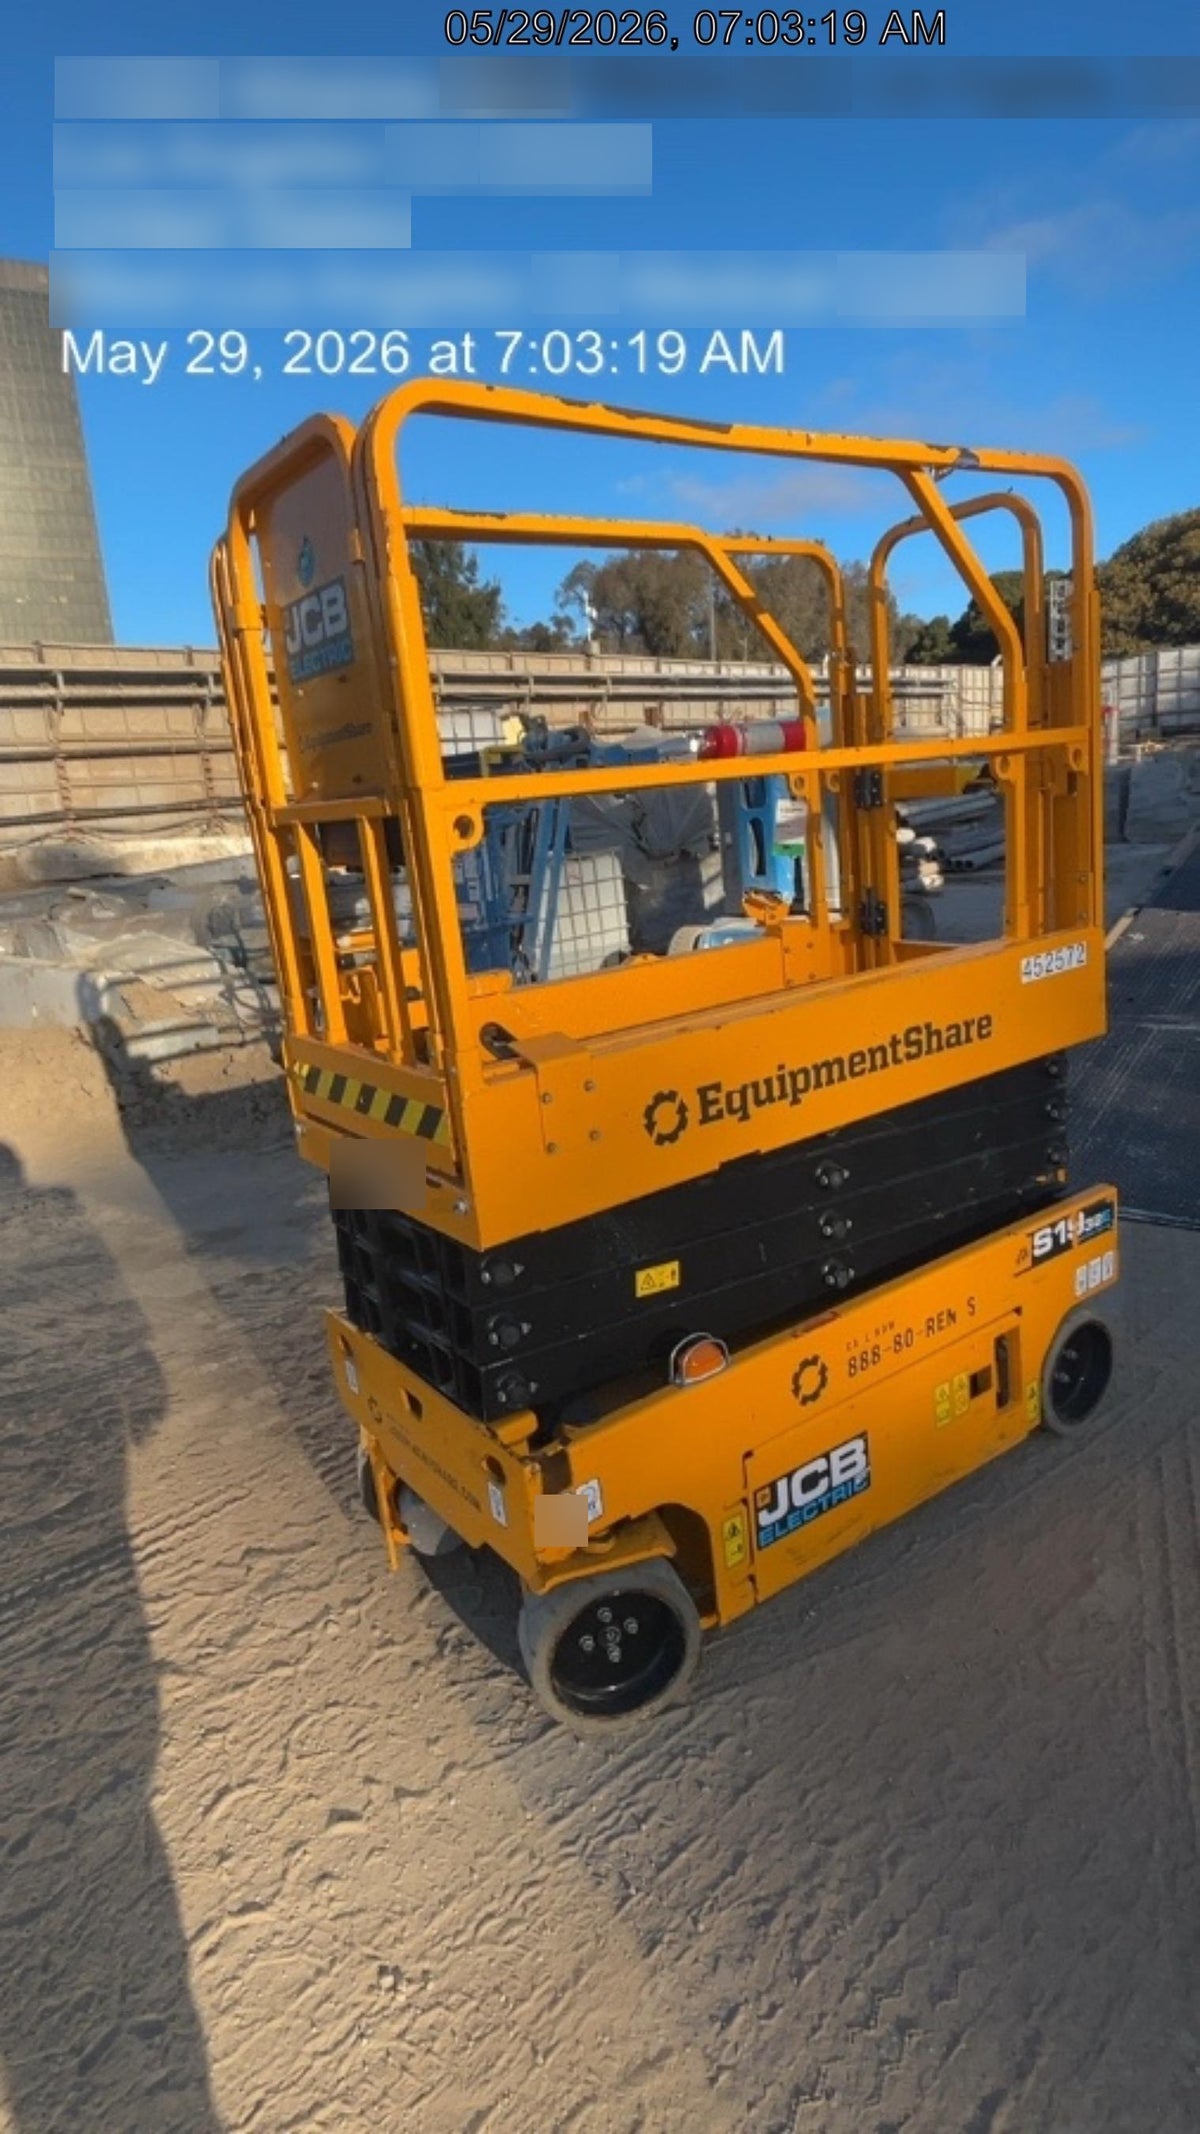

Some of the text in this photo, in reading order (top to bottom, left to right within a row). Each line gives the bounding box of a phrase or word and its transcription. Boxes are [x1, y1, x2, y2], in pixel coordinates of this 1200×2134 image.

[286, 582, 348, 655] JCB
[1024, 943, 1085, 978] 452572
[697, 1013, 993, 1124] EquipmentShare
[758, 1438, 867, 1527] JCB
[759, 1478, 868, 1547] ELECTRIC
